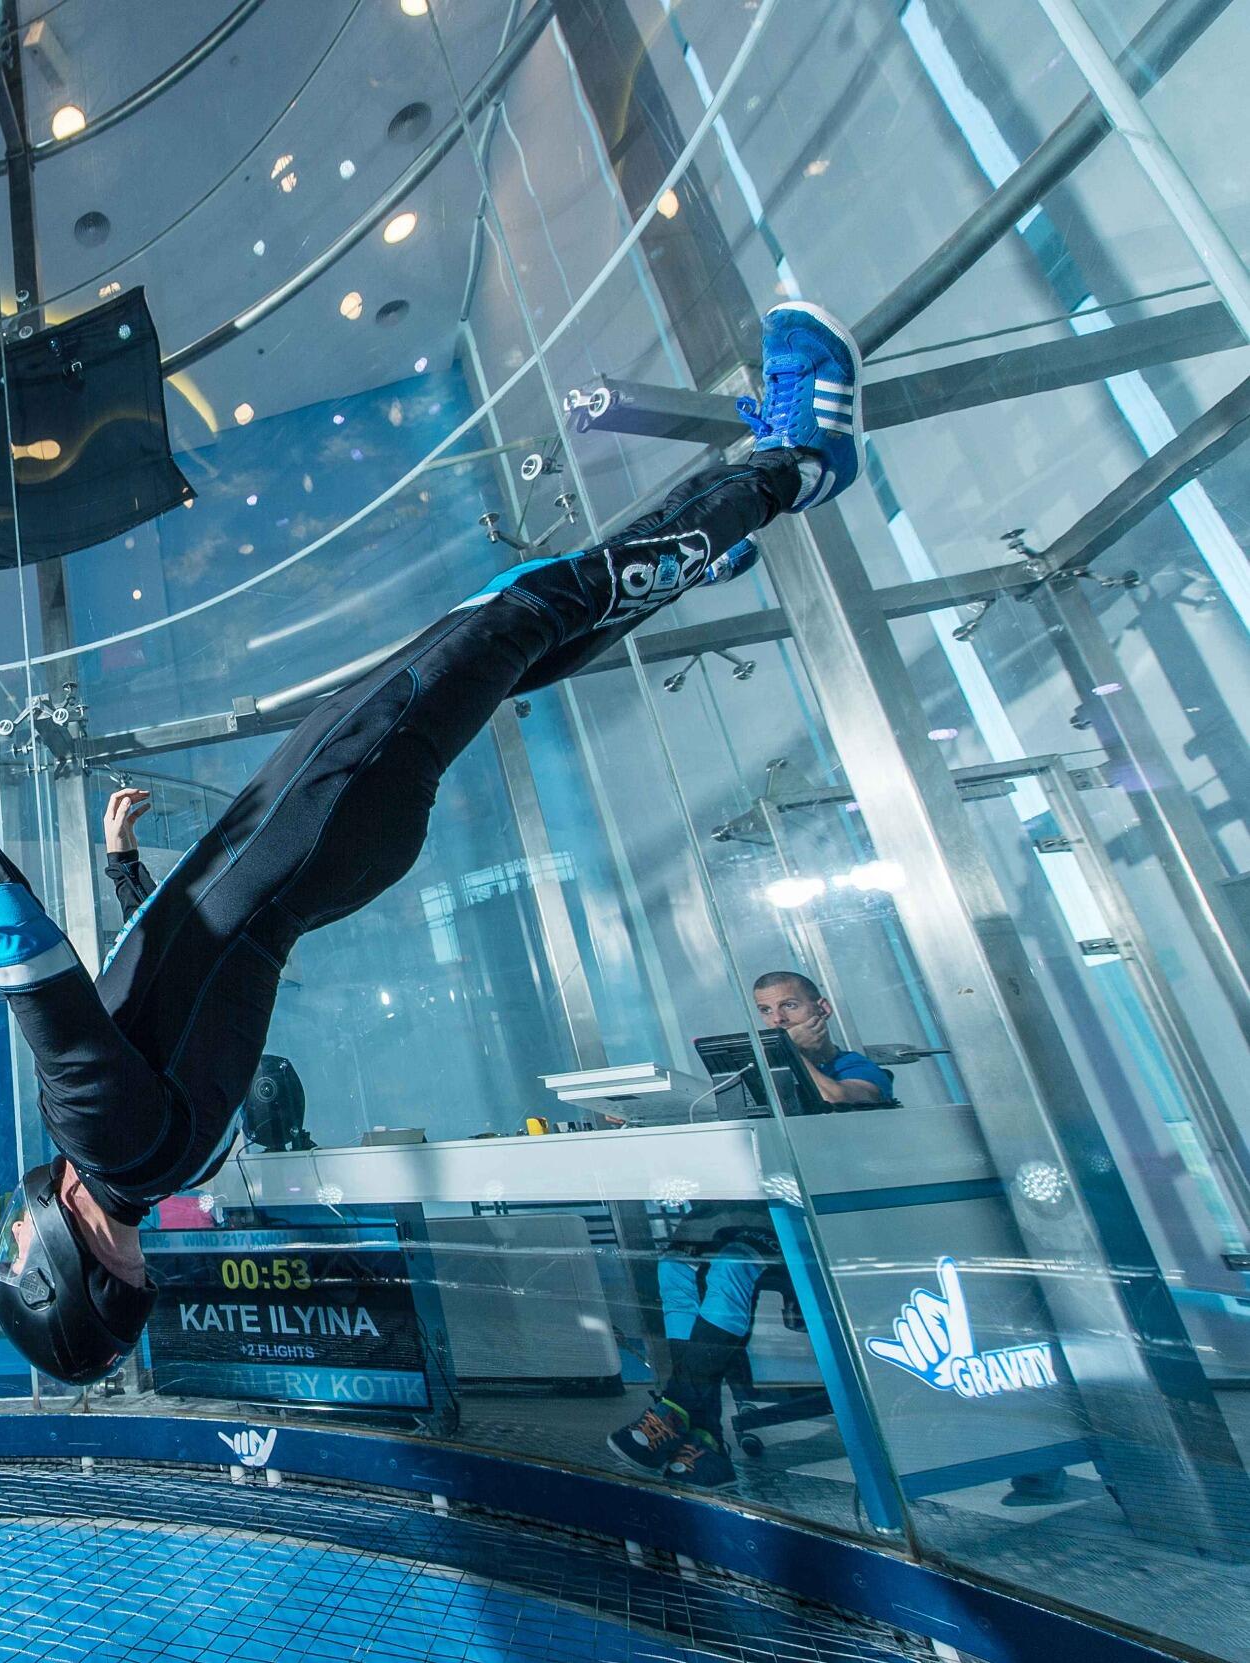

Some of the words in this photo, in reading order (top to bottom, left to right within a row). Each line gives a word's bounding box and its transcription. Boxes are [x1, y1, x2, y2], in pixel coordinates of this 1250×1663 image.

[182, 1232, 219, 1247] WIND
[223, 1232, 246, 1246] 217
[221, 1258, 312, 1290] 00:53
[179, 1303, 261, 1333] KATE
[269, 1305, 380, 1337] ILYINA
[240, 1344, 254, 1356] +2
[258, 1345, 315, 1359] FLIGHTS
[951, 1343, 1058, 1398] GRAVITY
[331, 1374, 424, 1401] KOTIK
